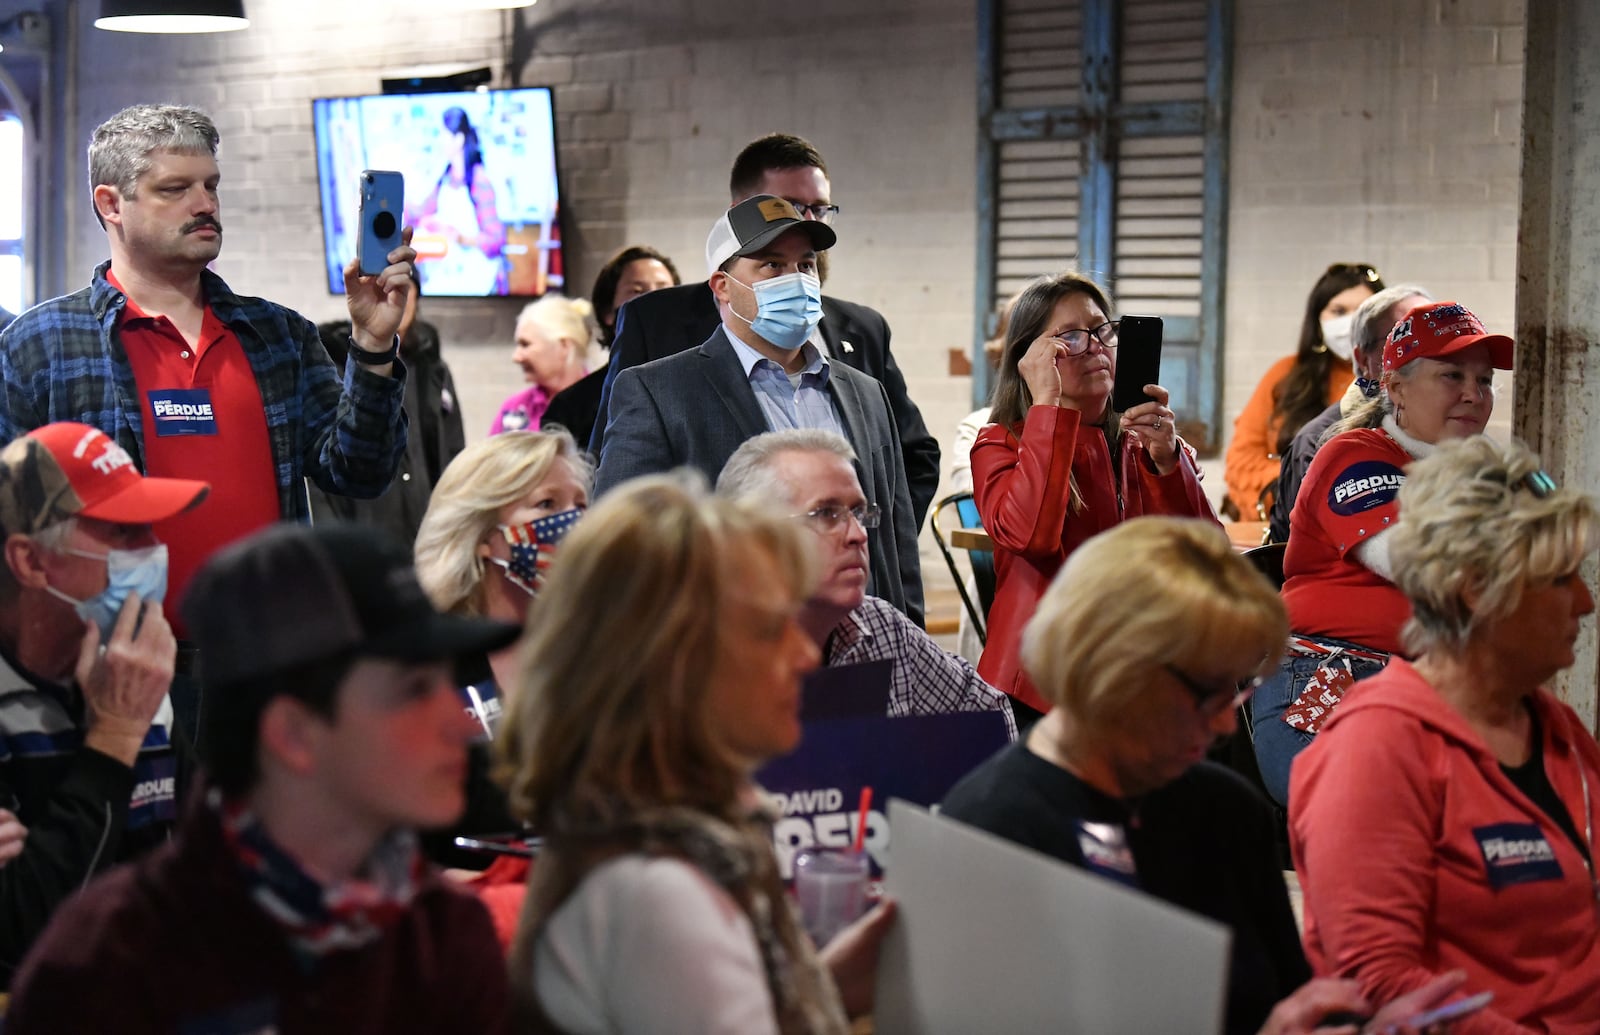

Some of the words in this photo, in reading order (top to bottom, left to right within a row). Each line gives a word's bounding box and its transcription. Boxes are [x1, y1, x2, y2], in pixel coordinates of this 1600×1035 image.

[154, 404, 213, 416] PERDUE
[1334, 479, 1355, 493] DAVID
[769, 788, 843, 816] DAVID
[773, 810, 892, 880] PER
